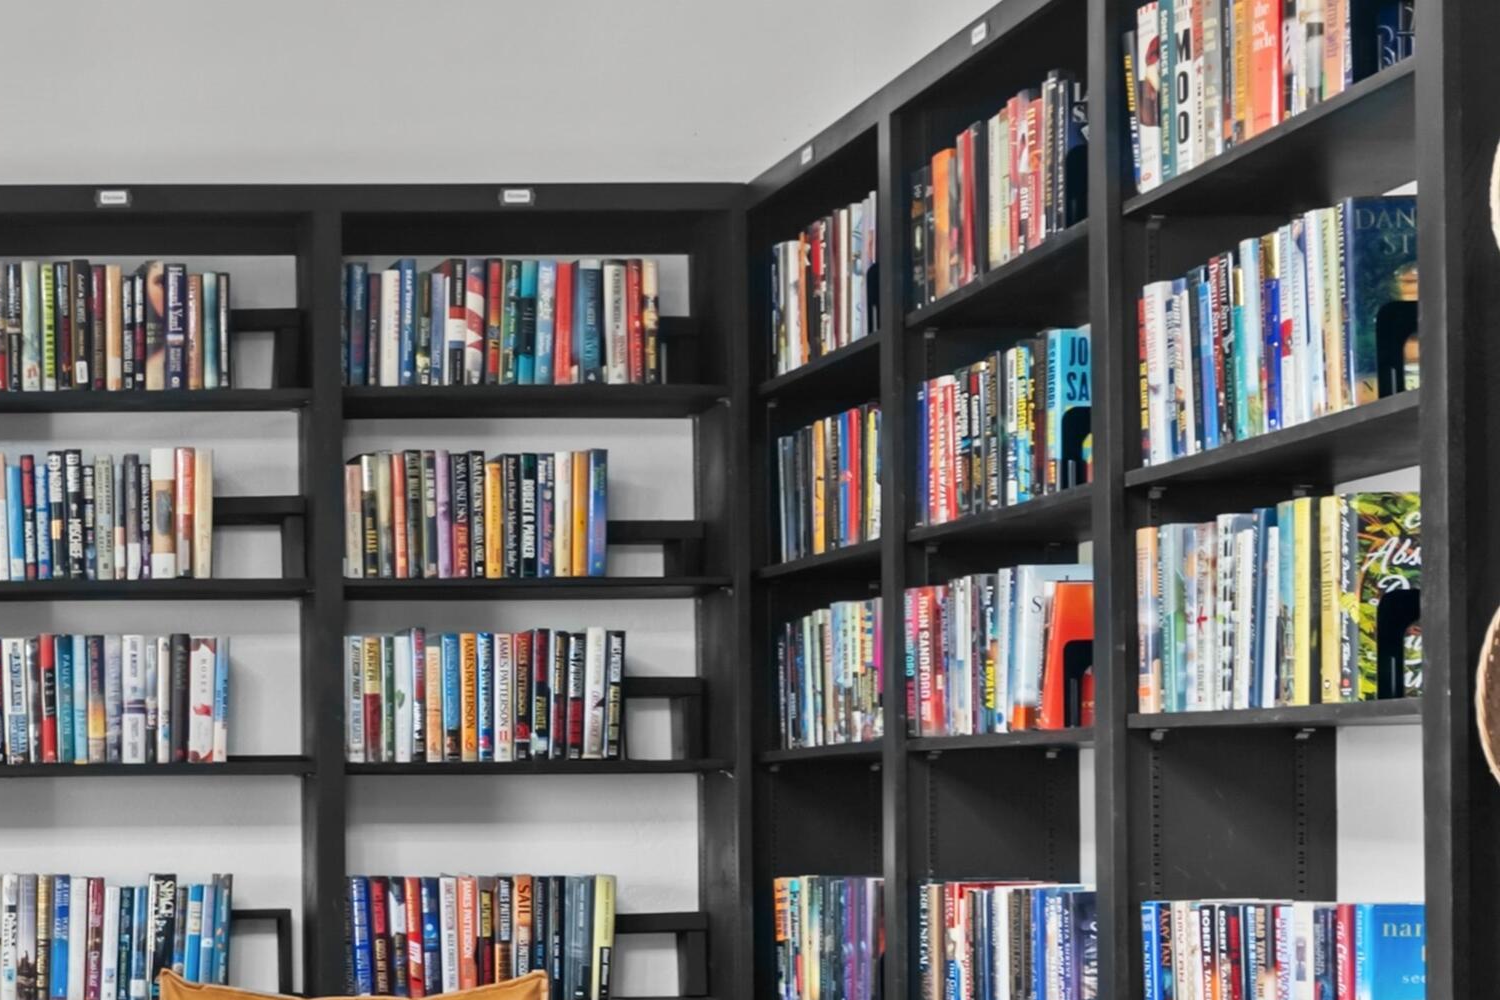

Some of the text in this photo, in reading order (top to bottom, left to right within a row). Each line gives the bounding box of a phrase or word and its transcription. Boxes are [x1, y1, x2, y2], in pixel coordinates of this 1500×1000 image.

[1160, 10, 1170, 156] SOME LUCK JANE SMILEY
[1176, 27, 1191, 145] MOO
[1019, 188, 1028, 219] OTHER
[1337, 203, 1347, 299] DANIELLE STEEL
[1140, 362, 1148, 376] THE
[1140, 410, 1148, 430] BONE
[989, 437, 998, 474] PHANTOM
[456, 456, 469, 567] SARA PARETSKY FIRE SALE
[523, 480, 535, 513] ROBERT
[523, 524, 535, 558] PARKER
[367, 642, 377, 682] PARKER
[918, 593, 930, 698] JOHN SANDFORD
[62, 655, 70, 689] PAULA
[465, 638, 475, 729] JAMES PATTERSON
[500, 637, 509, 727] JAMES PATTERSON
[518, 638, 527, 716] JAMES PATTERSON
[986, 660, 994, 709] LOYALTY
[159, 880, 175, 918] SPACE
[500, 880, 510, 941] JAMES PATTERSON
[518, 884, 530, 919] SAIL
[1160, 908, 1171, 967] AMY TAN
[1202, 909, 1213, 952] ROBERT
[1219, 910, 1228, 950] ROBERT
[1255, 908, 1265, 940] BRAD
[1143, 952, 1155, 998] KITCHEN
[1257, 982, 1265, 999] THE
